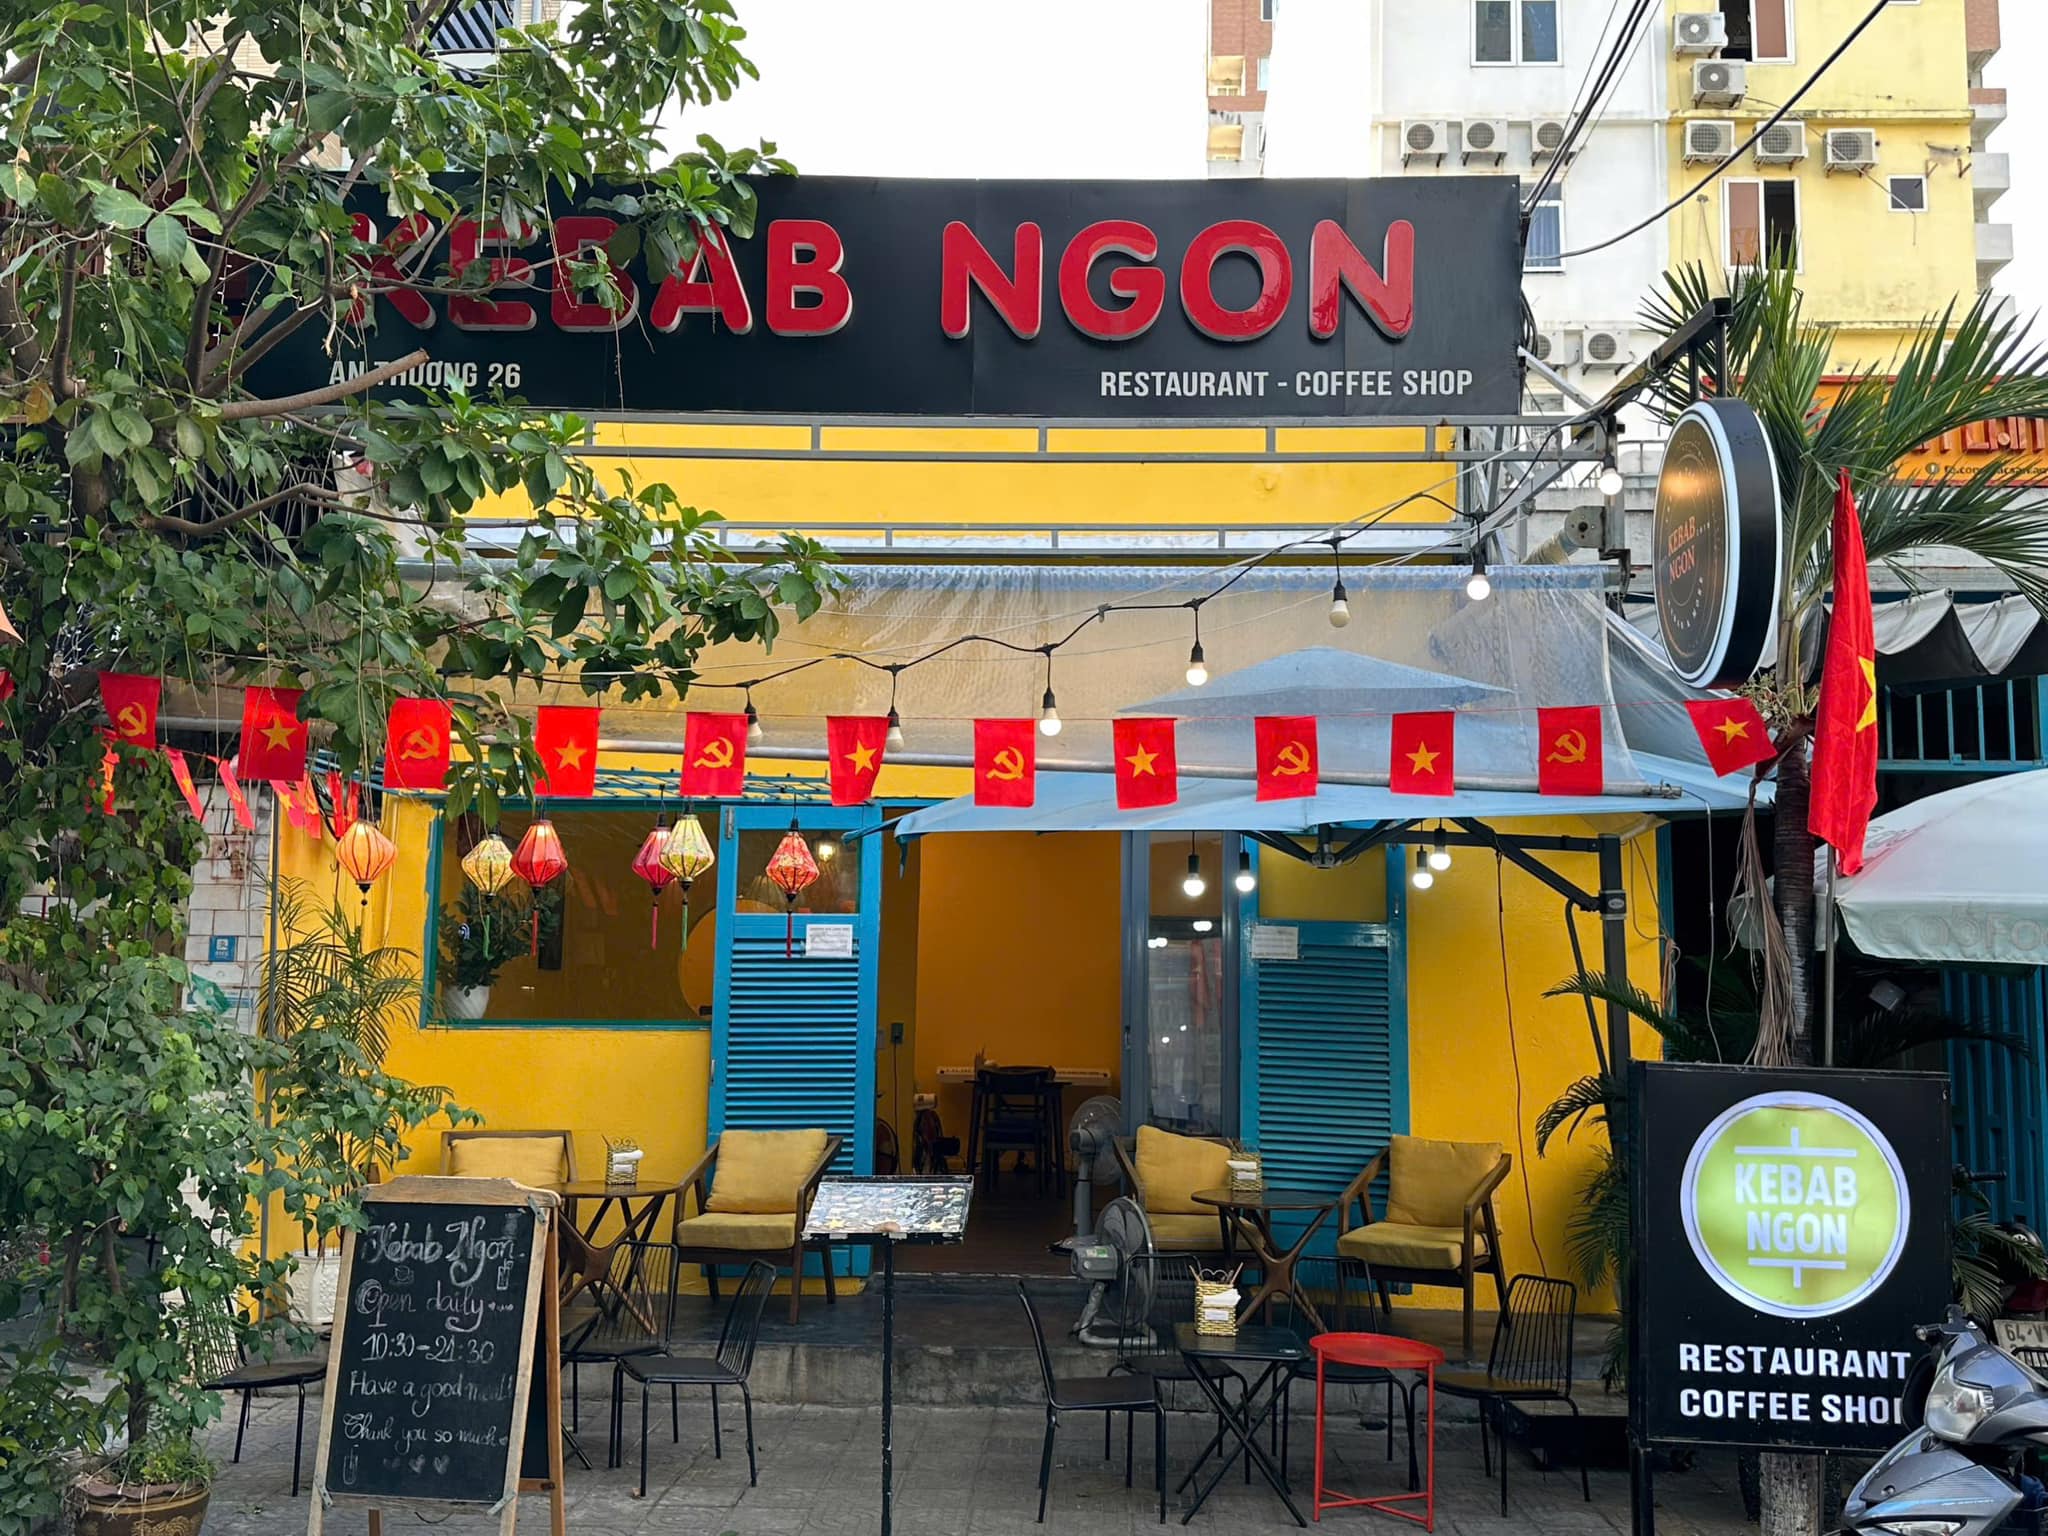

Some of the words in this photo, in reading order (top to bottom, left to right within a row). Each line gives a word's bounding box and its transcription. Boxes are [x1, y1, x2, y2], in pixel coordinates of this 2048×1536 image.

[346, 211, 853, 338] KEBAB
[940, 219, 1415, 341] NGON
[329, 360, 365, 385] AN
[488, 363, 521, 388] 26
[1100, 371, 1269, 397] RESTAURANT
[1295, 370, 1393, 397] COFFEE
[1402, 369, 1473, 396] SHOP
[1668, 515, 1697, 557] KEBAB
[1669, 543, 1696, 585] NGON
[1734, 1162, 1858, 1208] KEBAB
[360, 1221, 443, 1264] Kebab
[1746, 1210, 1848, 1256] NGON
[355, 1278, 417, 1328] Open
[426, 1280, 485, 1333] daily
[1679, 1343, 1912, 1379] RESTAURANT
[350, 1370, 398, 1397] Have
[402, 1381, 415, 1398] a
[411, 1373, 464, 1418] good
[1679, 1388, 1811, 1422] COFFEE
[343, 1411, 394, 1440] Thank
[395, 1428, 428, 1454] you
[434, 1430, 453, 1443] so
